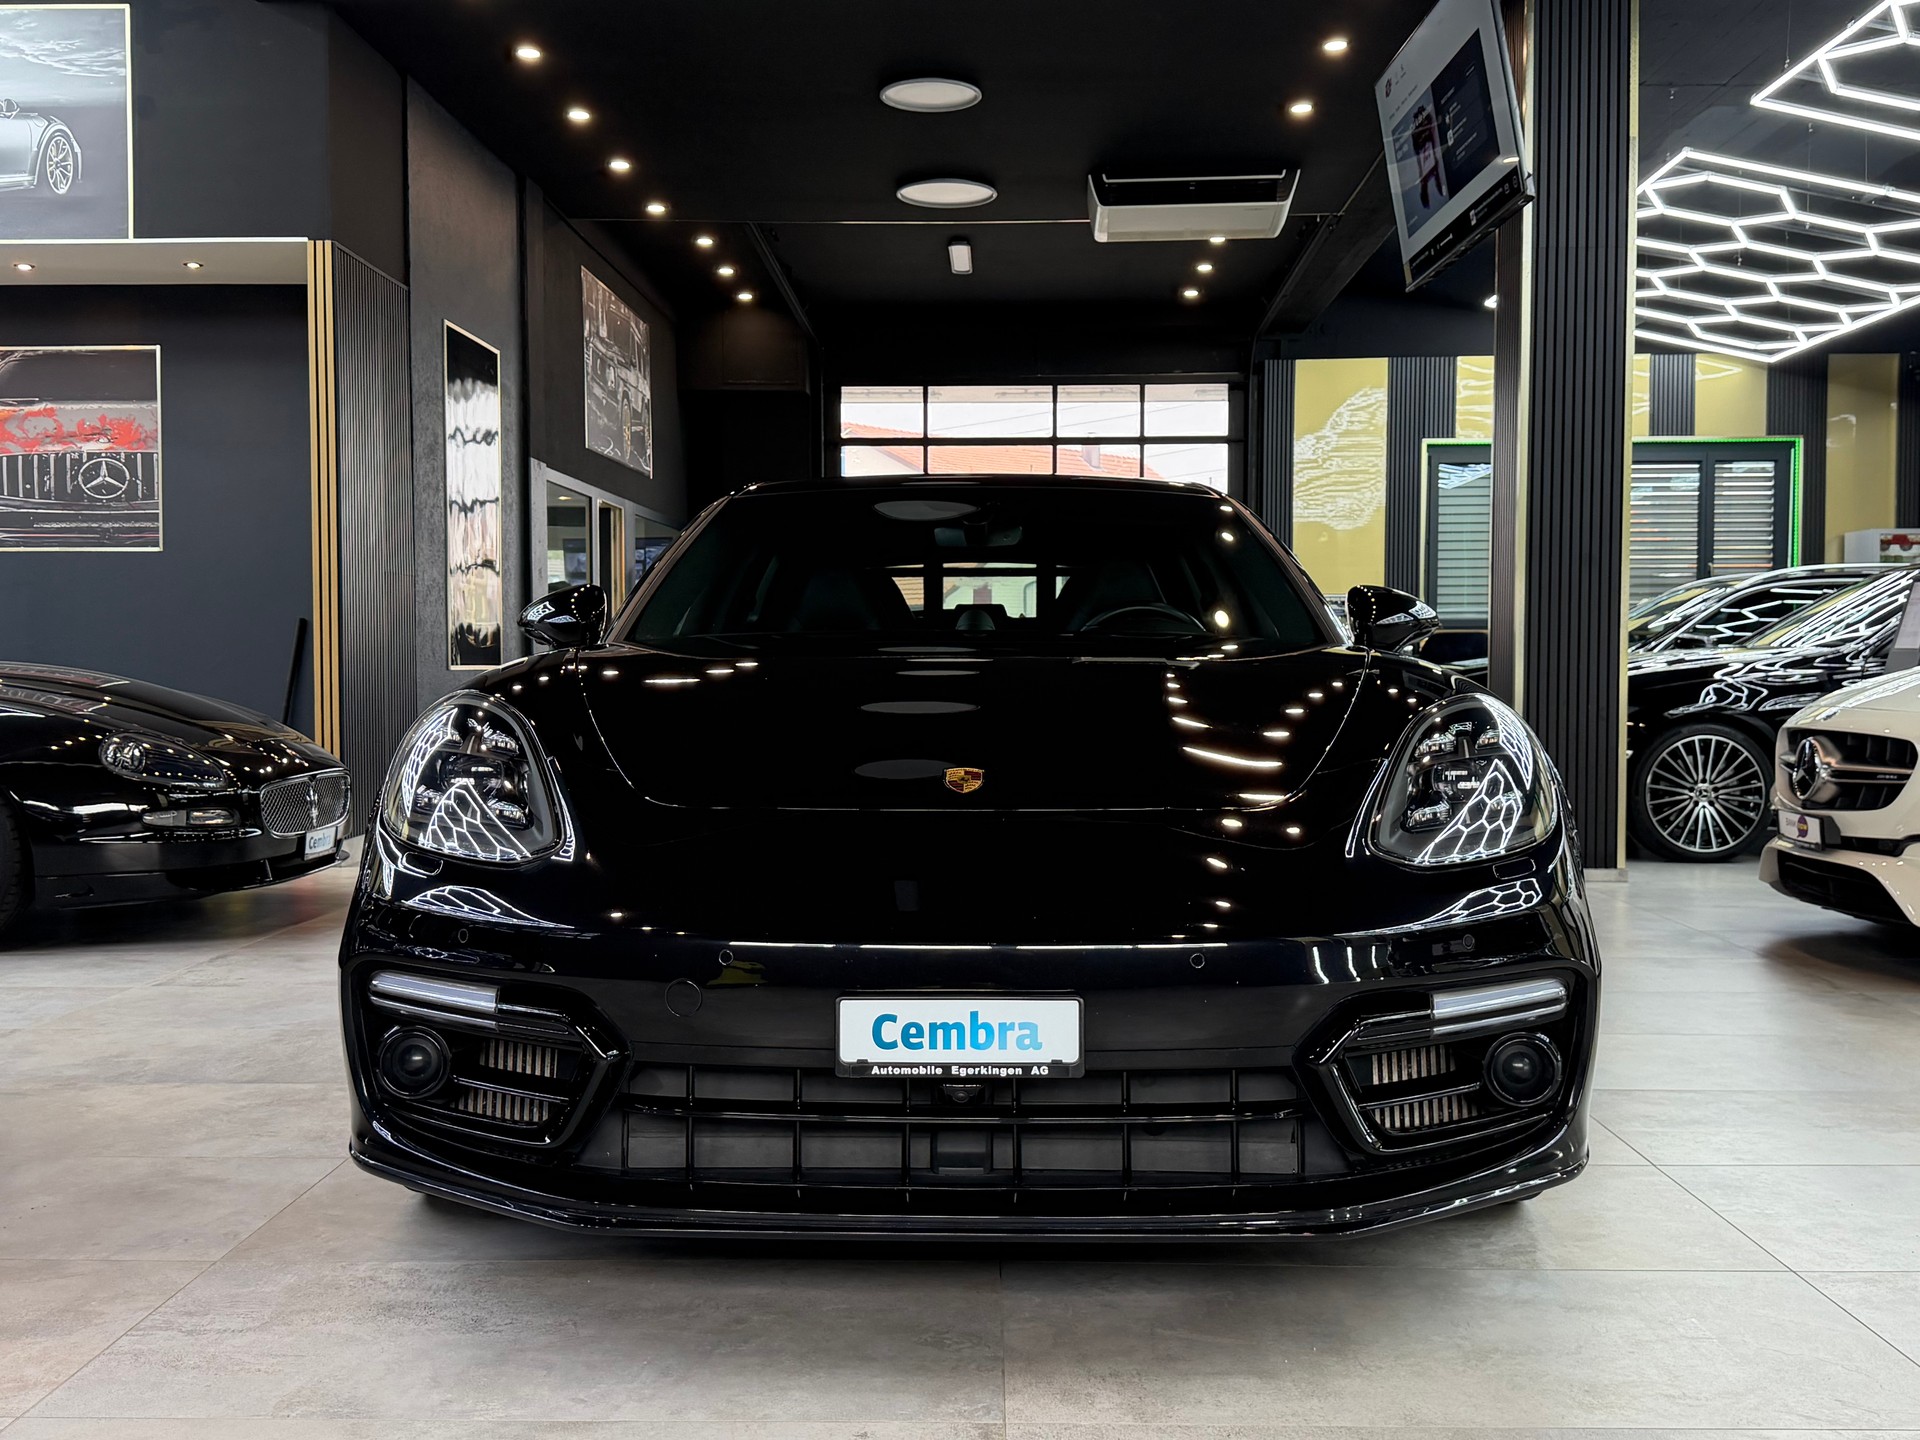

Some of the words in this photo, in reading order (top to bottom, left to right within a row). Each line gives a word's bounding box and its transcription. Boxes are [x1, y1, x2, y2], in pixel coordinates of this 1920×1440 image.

[872, 1010, 1043, 1051] Cembra
[871, 1065, 943, 1075] Automobile
[951, 1065, 1022, 1077] Egerkingen
[1031, 1065, 1049, 1076] AG
